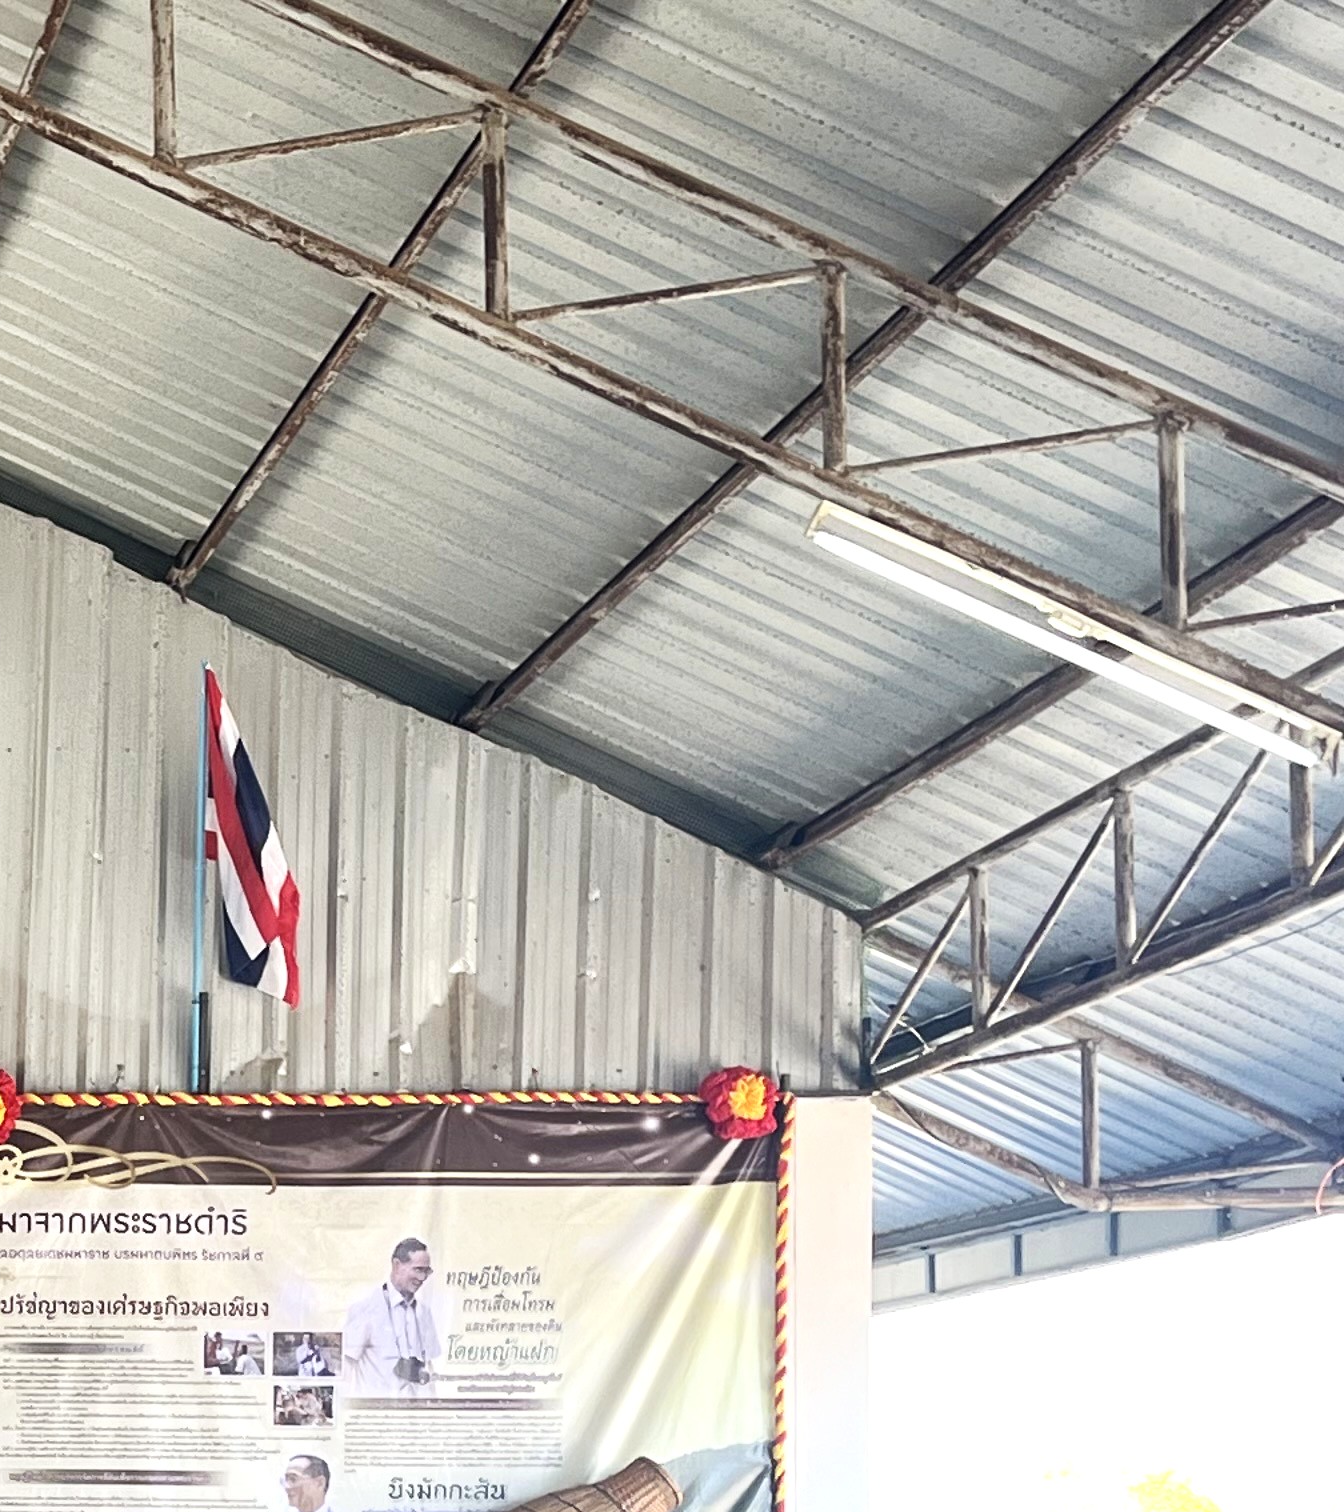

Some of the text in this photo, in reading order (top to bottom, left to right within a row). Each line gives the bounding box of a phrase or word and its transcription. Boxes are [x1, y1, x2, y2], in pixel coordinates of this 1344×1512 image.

[0, 1291, 270, 1320] ปรัชญาของเศรษฐกิจพอเพียง
[388, 1477, 506, 1501] บึงมักกะสัน
